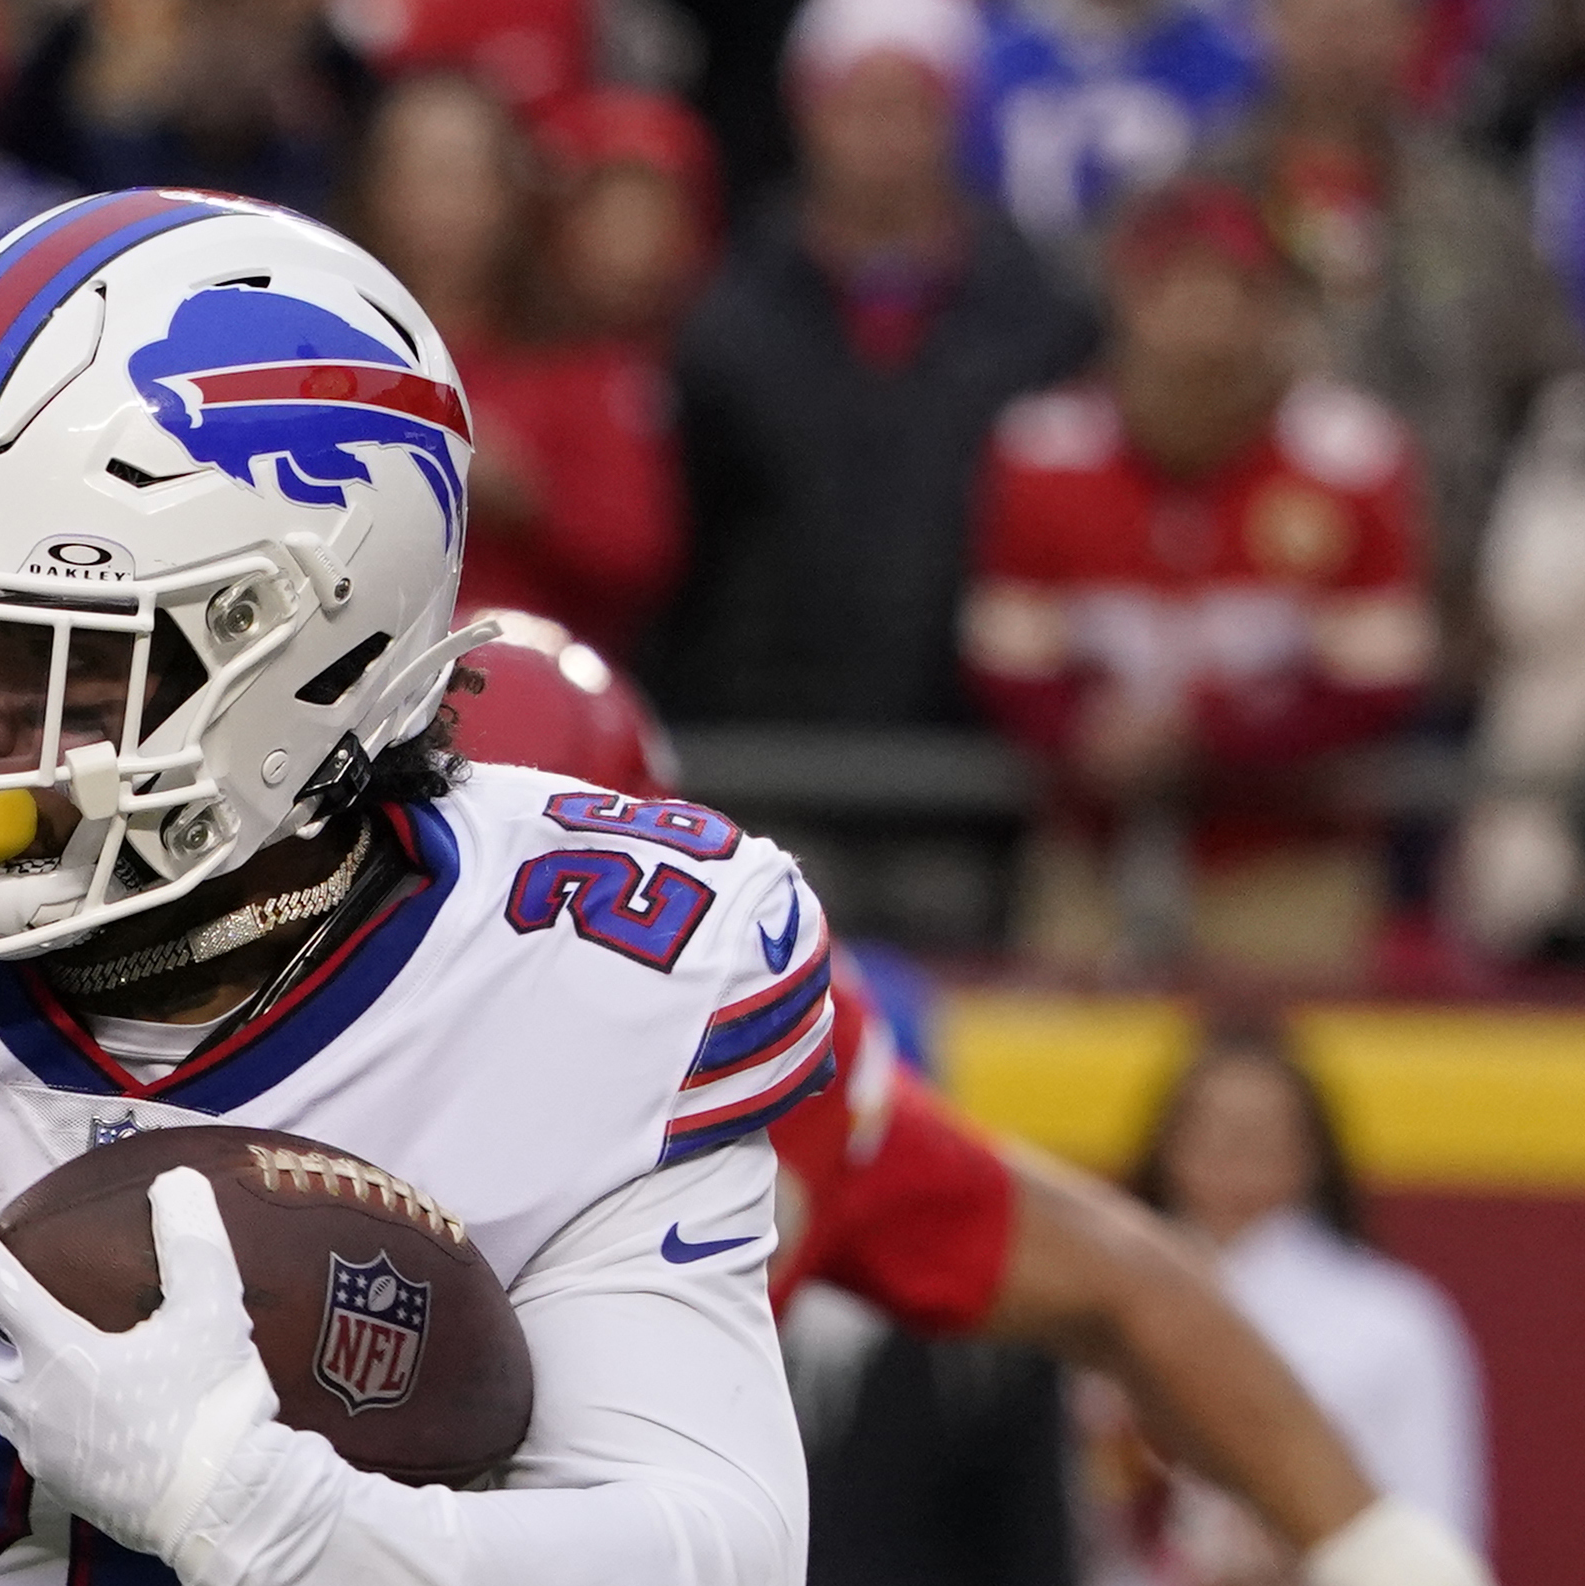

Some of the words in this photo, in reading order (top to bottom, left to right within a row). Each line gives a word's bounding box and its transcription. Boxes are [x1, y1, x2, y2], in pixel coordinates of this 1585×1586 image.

[29, 563, 127, 581] OAKLEY
[504, 791, 743, 975] 26
[327, 1313, 407, 1395] NFL
